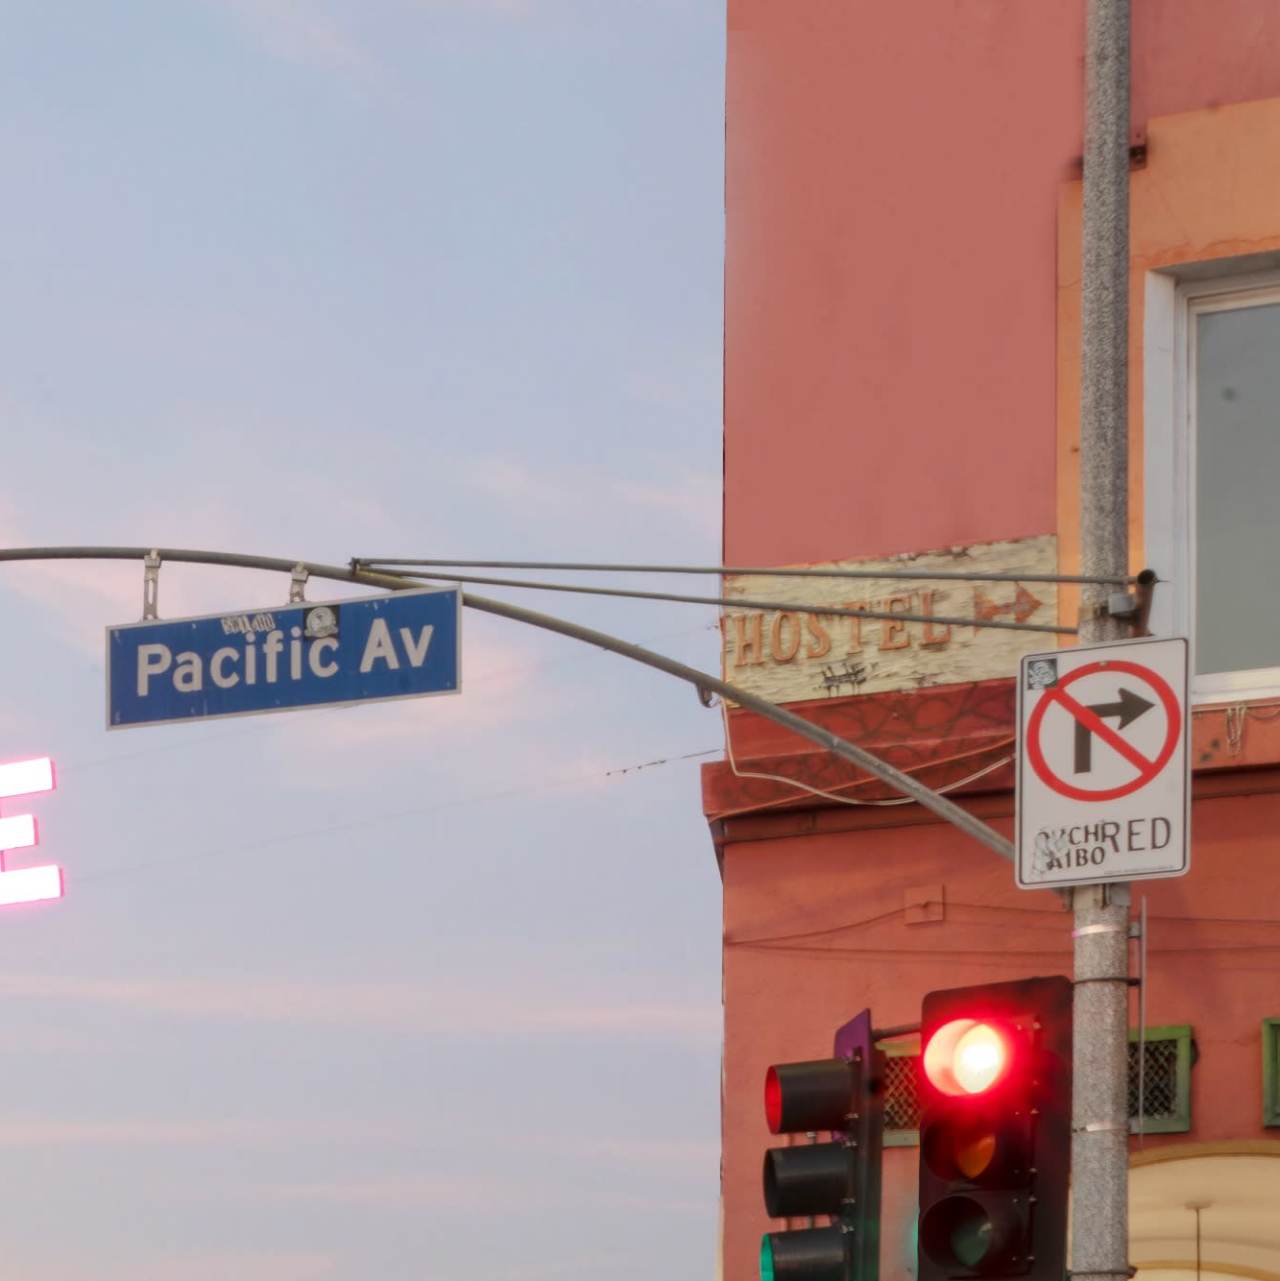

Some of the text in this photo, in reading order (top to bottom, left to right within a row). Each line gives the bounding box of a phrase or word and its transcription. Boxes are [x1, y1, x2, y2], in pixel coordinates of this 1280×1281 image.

[137, 617, 435, 697] Pacific Av
[734, 590, 952, 667] HOSTEL
[1102, 817, 1172, 853] RED
